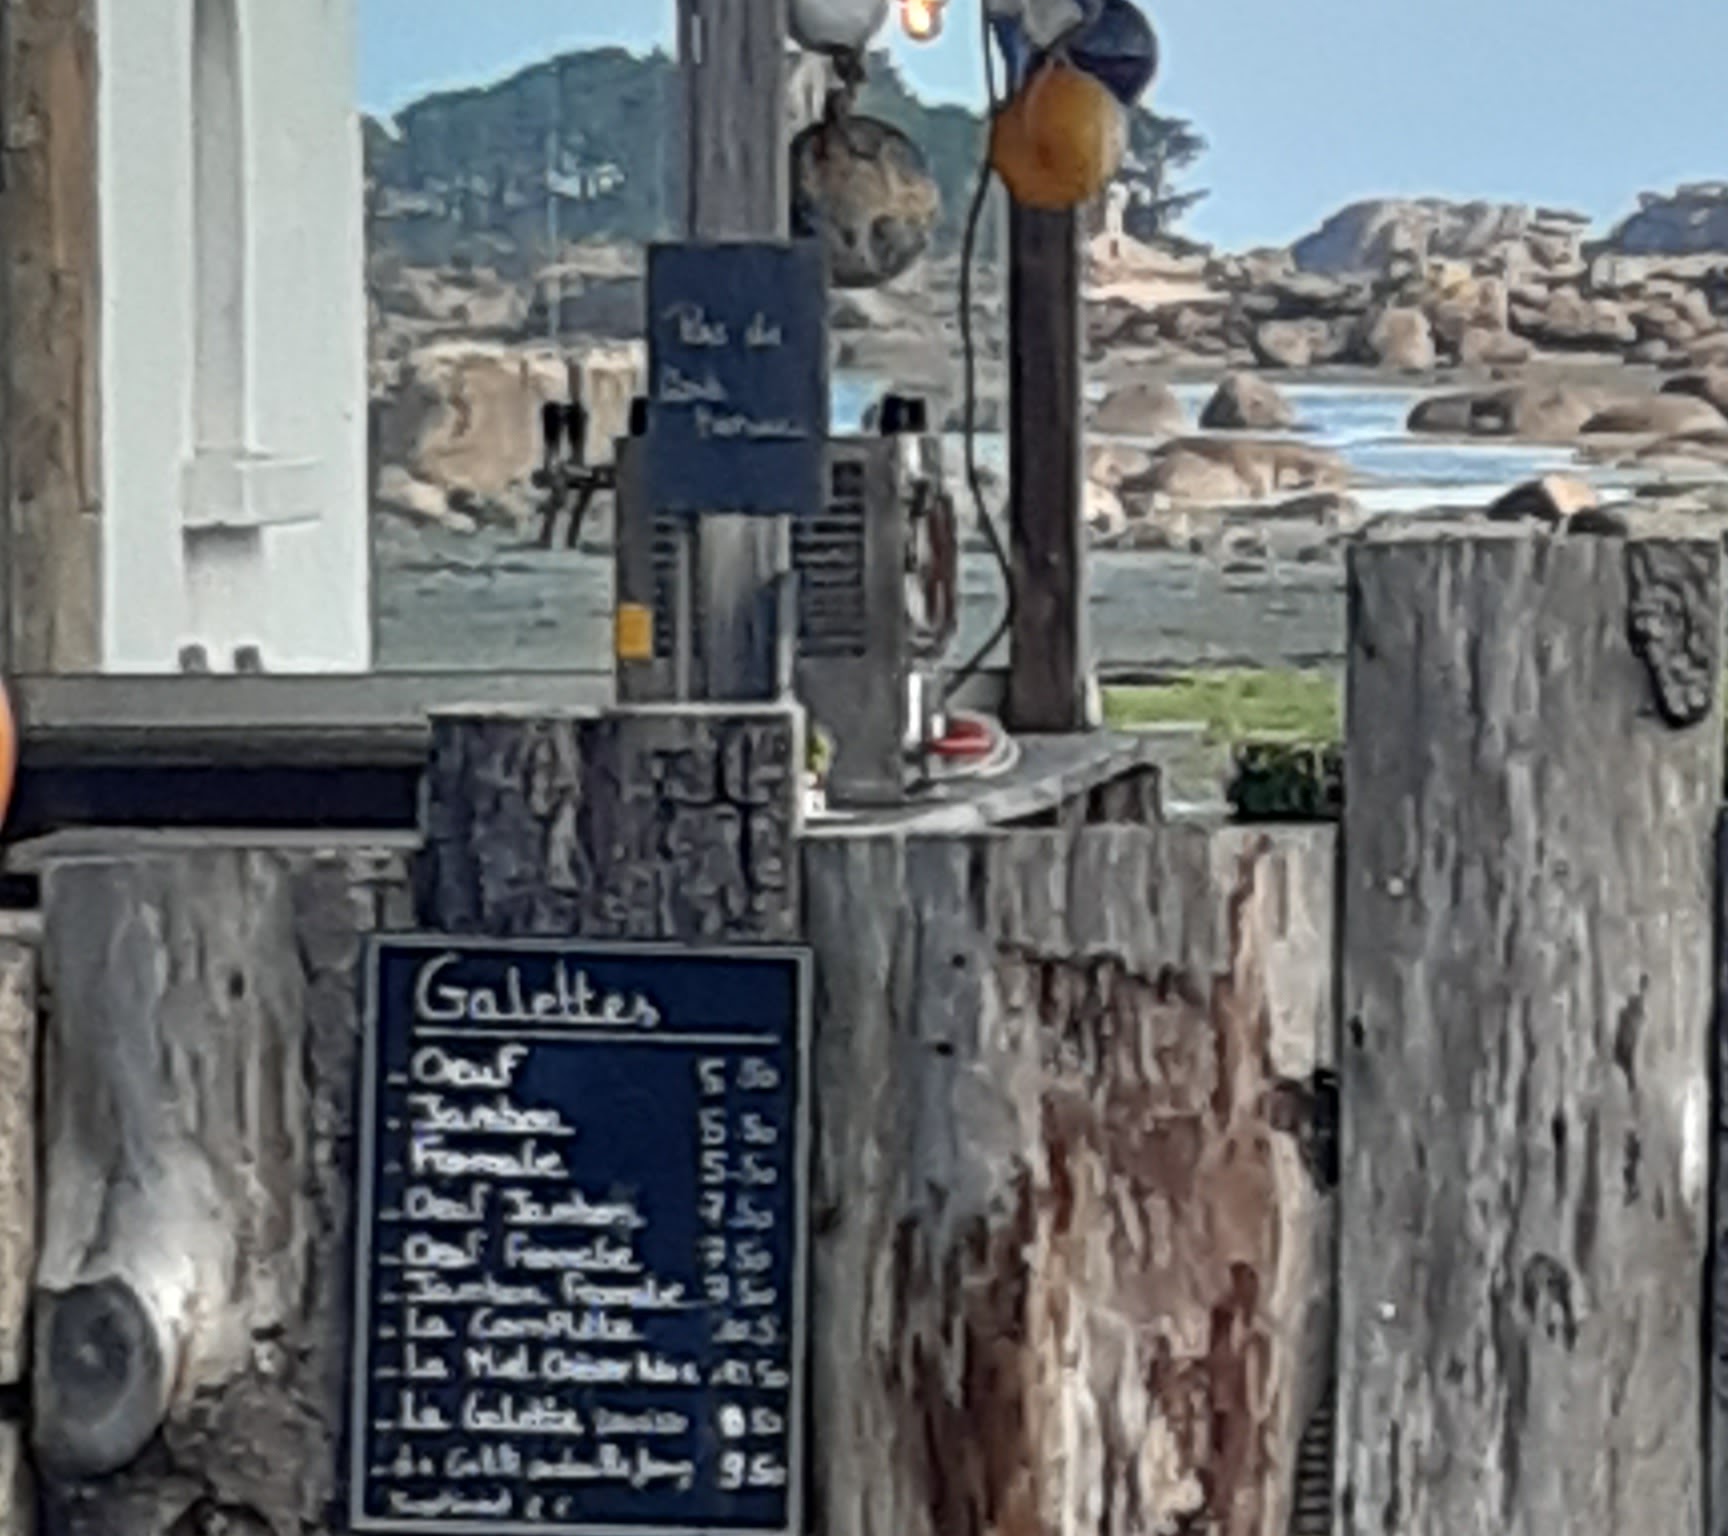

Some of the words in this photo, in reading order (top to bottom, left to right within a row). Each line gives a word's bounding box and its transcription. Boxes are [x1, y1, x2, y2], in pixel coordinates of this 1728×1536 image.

[414, 952, 661, 1028] Galettes
[411, 1043, 528, 1087] Oeuf
[407, 1093, 576, 1136] Jambon
[701, 1149, 729, 1184] 5
[403, 1182, 491, 1222] Oeuf
[403, 1230, 489, 1268] Oeuf
[405, 1306, 456, 1341] La
[405, 1341, 450, 1379] La
[400, 1389, 451, 1433] La
